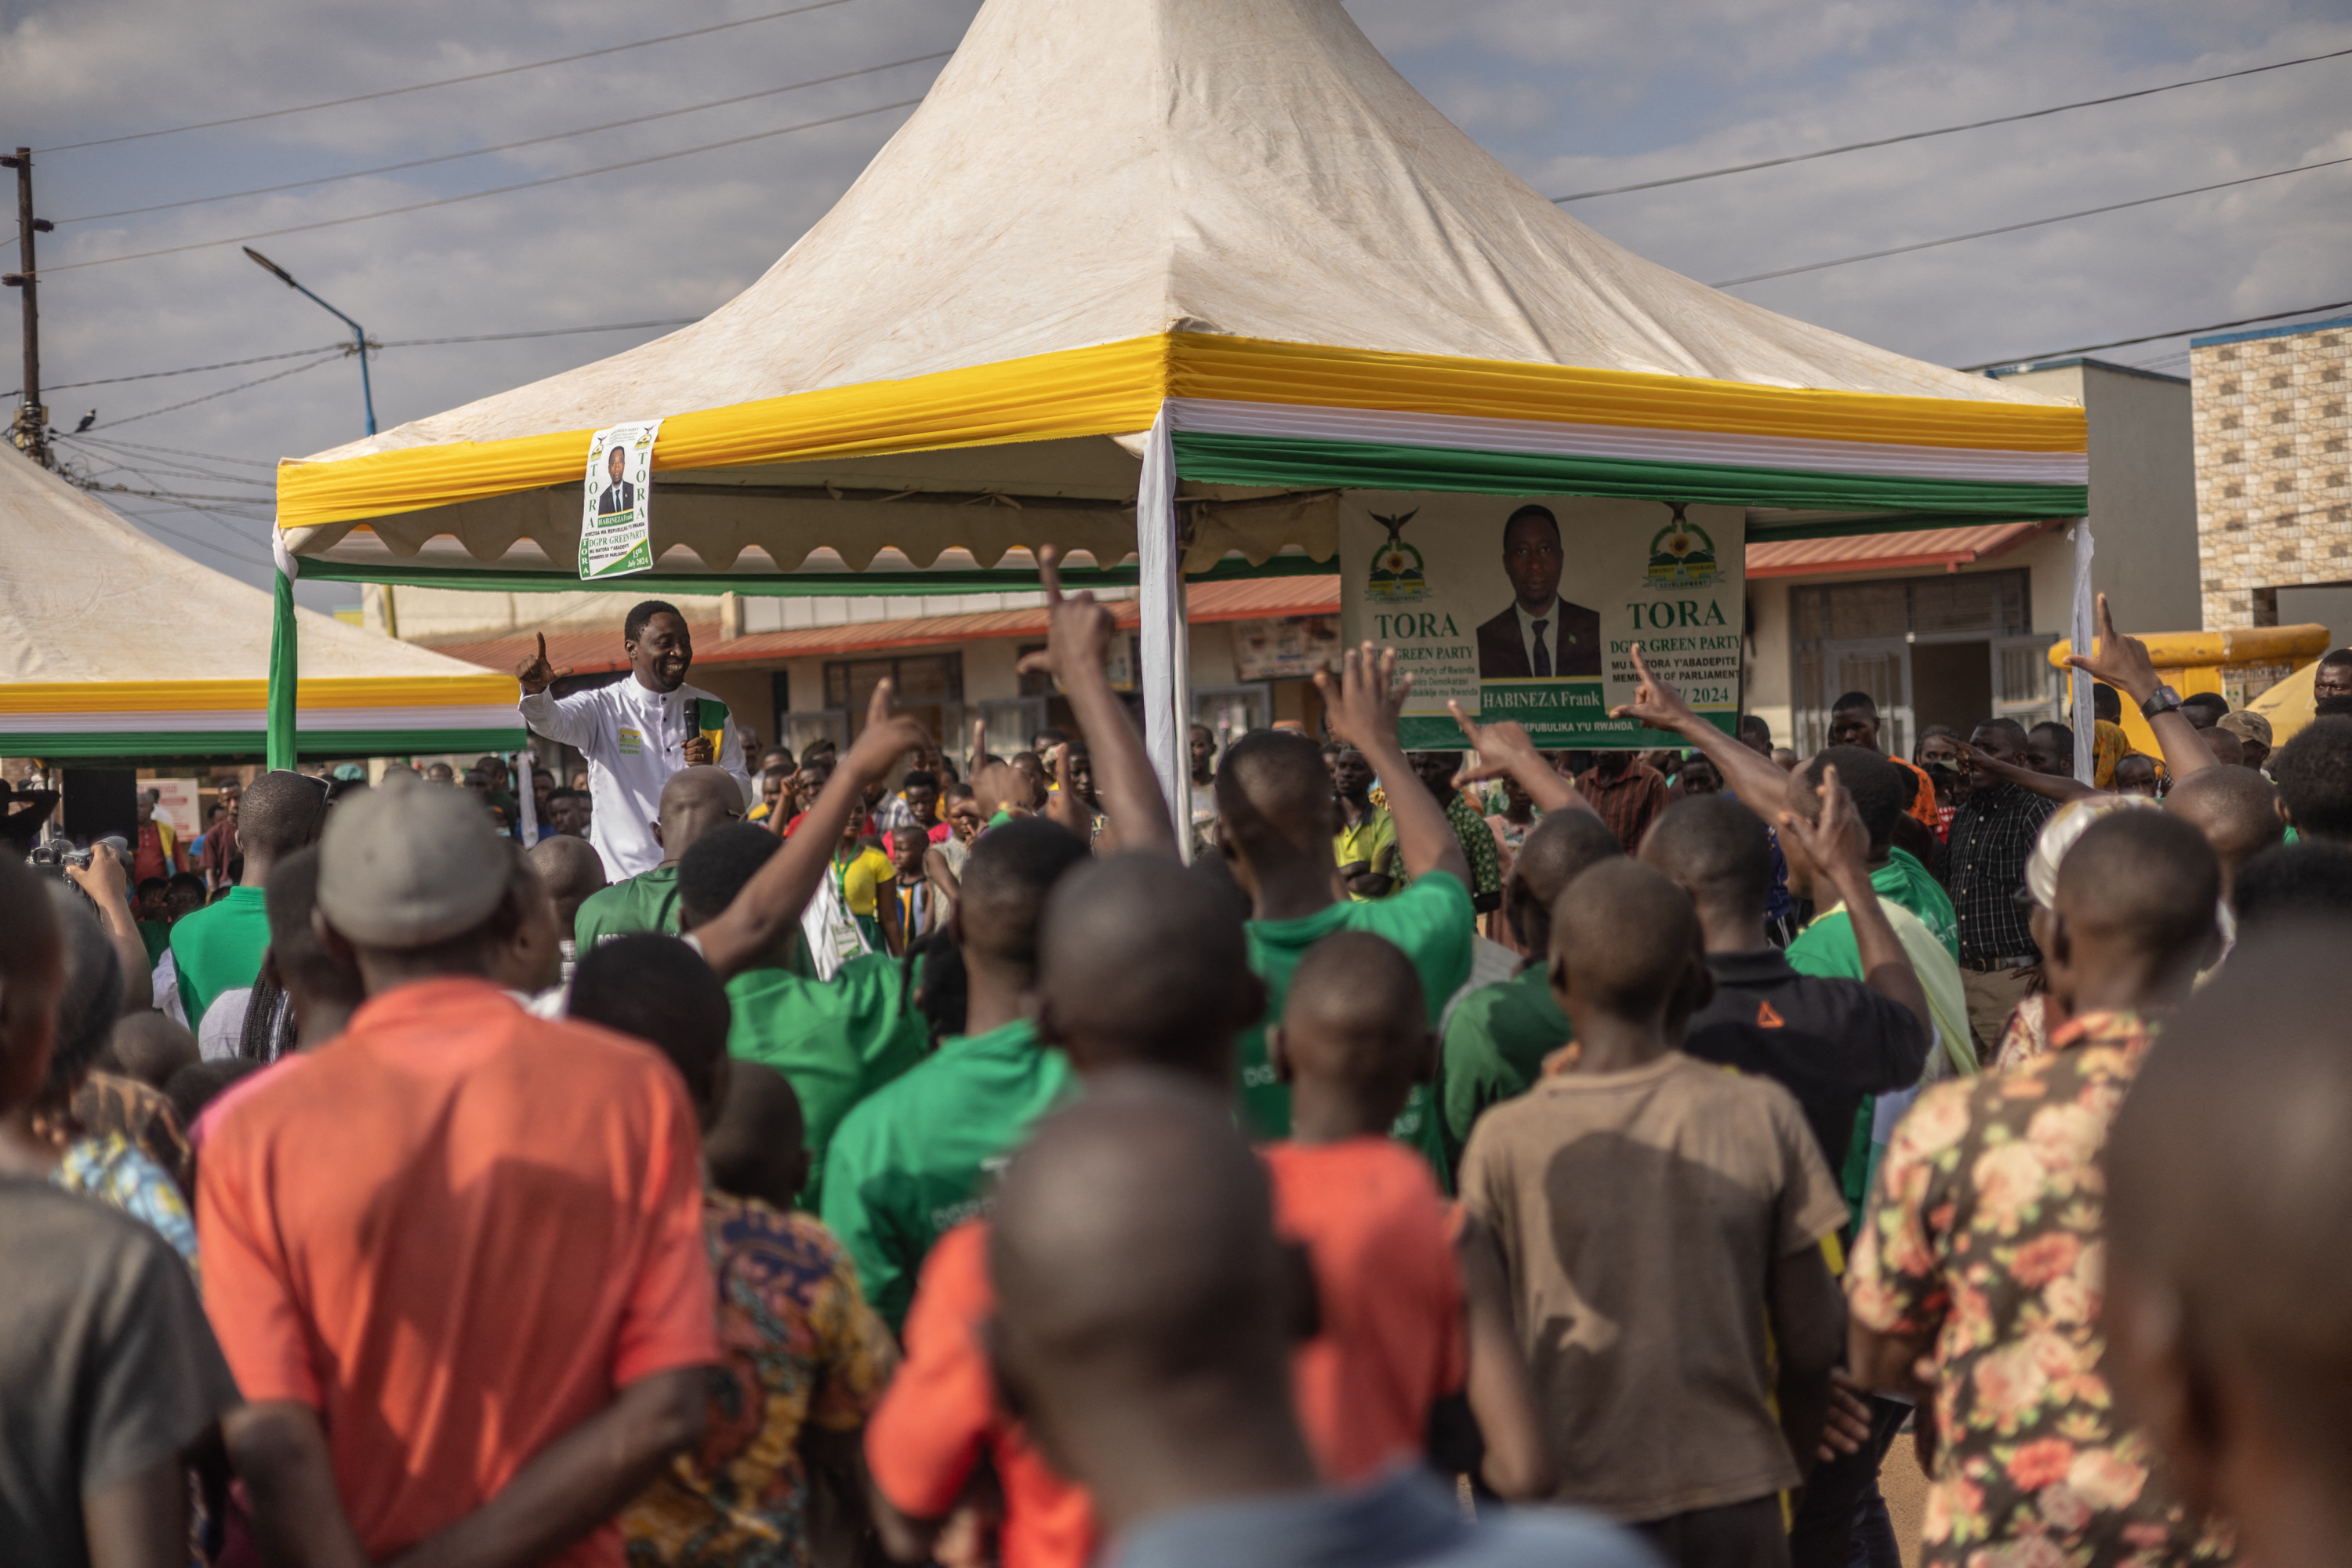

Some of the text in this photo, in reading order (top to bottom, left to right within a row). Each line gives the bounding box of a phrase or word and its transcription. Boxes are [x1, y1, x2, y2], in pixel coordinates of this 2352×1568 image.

[636, 452, 648, 519] TORA
[586, 463, 598, 529] TORA
[598, 517, 625, 525] HABINEZA
[589, 529, 646, 547] DGPR GREEN PARTY
[633, 547, 642, 558] 15th
[1660, 580, 1707, 589] DEVELOPMENT
[1626, 598, 1727, 630] TORA
[1374, 612, 1461, 639] TORA
[1610, 635, 1740, 654] DGR GREEN PARTY
[1396, 648, 1433, 660] GREEN
[1437, 647, 1473, 659] PARTY
[1611, 657, 1737, 670] MU MTORA Y'ABADEPITE
[1420, 666, 1437, 677] Party
[1439, 666, 1446, 675] of
[1448, 666, 1475, 675] Rwanda
[1612, 670, 1740, 683] MEMBS OF PARLIAMENT
[1429, 677, 1468, 686] Demokarasi
[1451, 688, 1478, 698] Rwanda
[1483, 691, 1600, 708] HABINEZA Frank
[1692, 687, 1729, 702] 2024
[1576, 722, 1590, 731] Y'U
[1594, 722, 1634, 731] RWANDA
